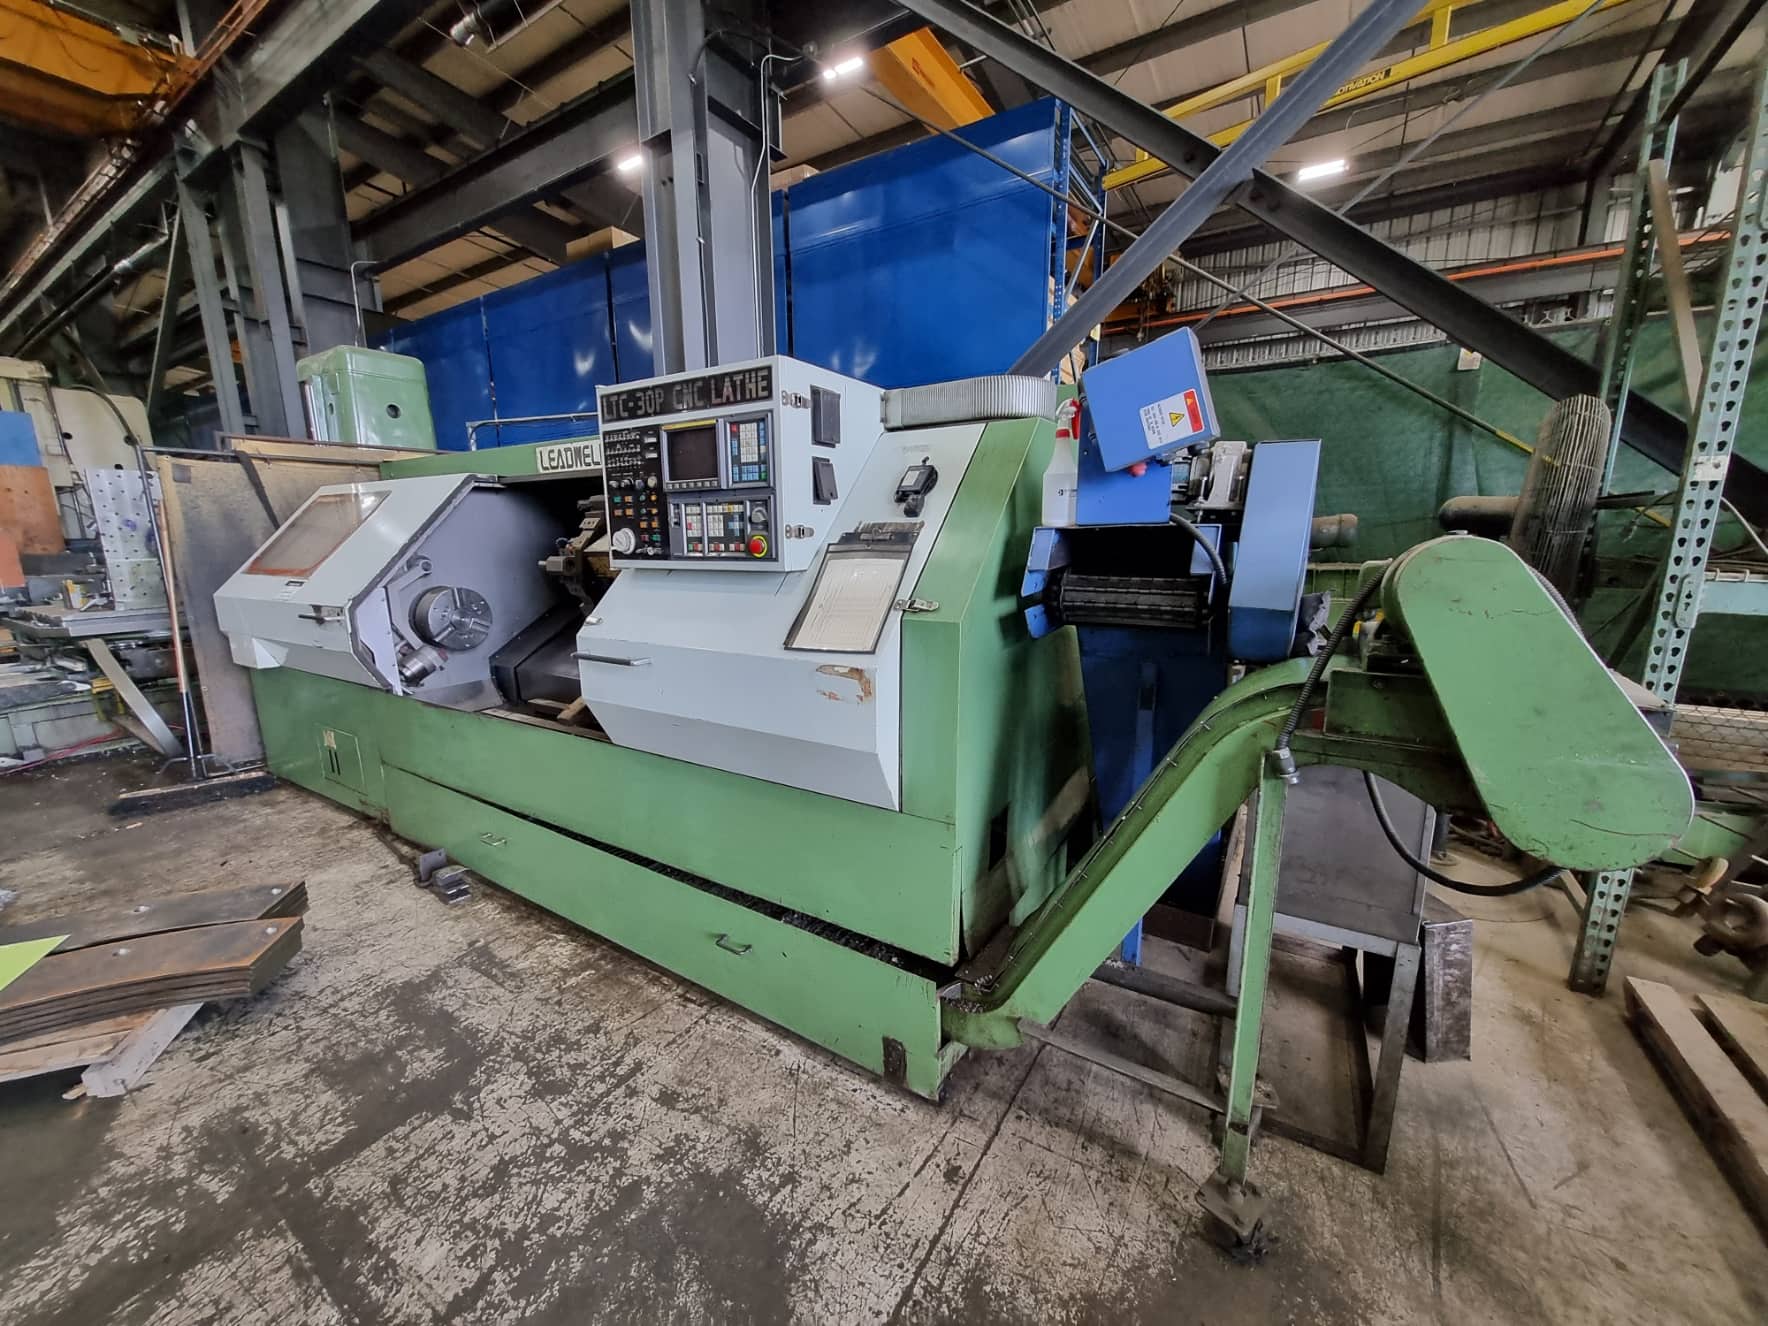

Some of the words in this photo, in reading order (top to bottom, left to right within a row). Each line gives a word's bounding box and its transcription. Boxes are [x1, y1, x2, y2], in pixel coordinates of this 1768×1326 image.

[603, 388, 664, 421] LTC-30P
[672, 381, 703, 410] CNC
[711, 369, 769, 403] LATHE
